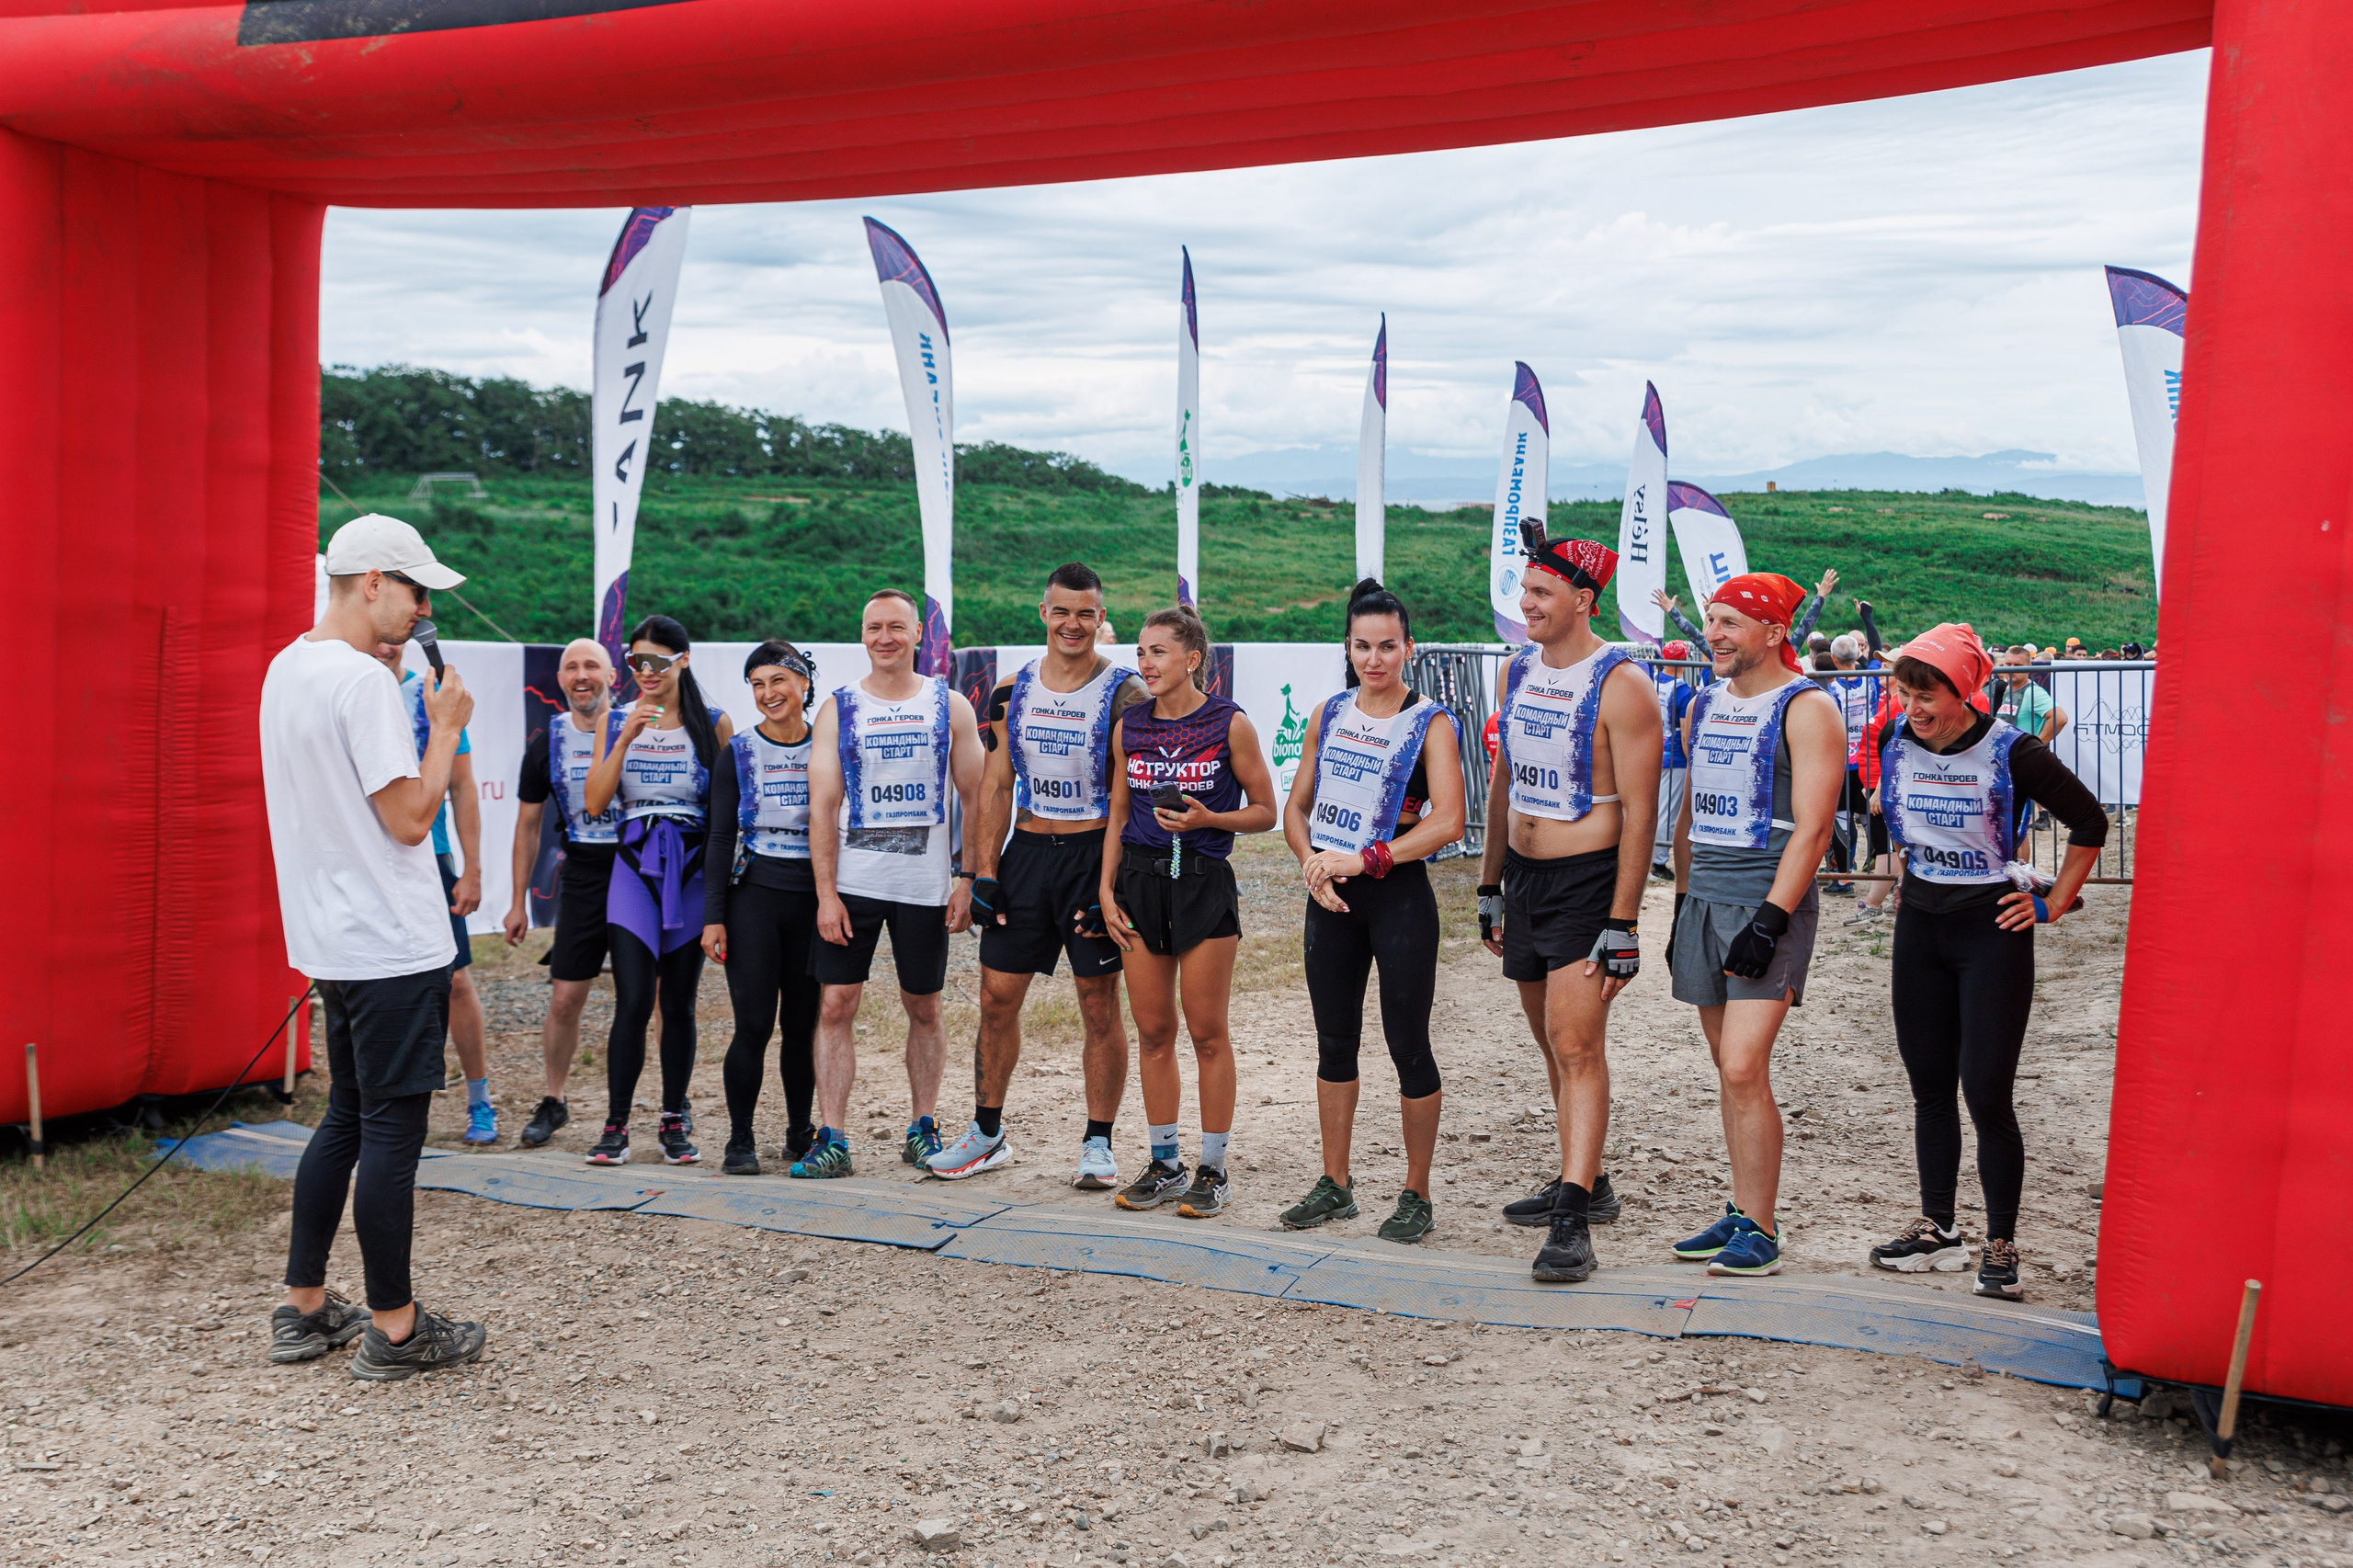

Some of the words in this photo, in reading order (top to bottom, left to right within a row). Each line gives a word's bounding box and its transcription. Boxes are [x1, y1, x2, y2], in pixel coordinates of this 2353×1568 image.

[612, 289, 654, 535] ANK
[1526, 684, 1544, 693] ГОНКА
[1546, 687, 1574, 699] ГЕРОЕВ
[1031, 707, 1055, 715] ГОНКА
[1057, 710, 1086, 718] ГЕРОЕВ
[1516, 706, 1569, 727] КОМАНДНЫЙ
[1027, 727, 1085, 744] КОМАНДНЫЙ
[1336, 728, 1359, 739] ГОНКА
[1360, 734, 1390, 746] ГЕРОЕВ
[1526, 722, 1551, 737] СТАРТ
[866, 733, 927, 747] КОМАНДНЫЙ
[1700, 735, 1751, 751] КОМАНДНЫЙ
[883, 747, 912, 758] СТАРТ
[1041, 742, 1067, 754] СТАРТ
[1324, 748, 1381, 772] КОМАНДНЫЙ
[1710, 751, 1733, 763] СТАРТ
[627, 761, 686, 772] КОМАНДНЫЙ
[1127, 758, 1221, 778] НСТРУКТОР
[1334, 763, 1361, 780] СТАРТ
[642, 772, 669, 781] СТАРТ
[1514, 762, 1559, 790] 04910
[1913, 772, 1943, 781] ГОНКА
[1944, 774, 1978, 782] ГЕРОЕВ
[764, 783, 807, 795] КОМАНДН
[871, 783, 926, 803] 04908
[1033, 778, 1082, 798] 04901
[781, 794, 807, 805] СТАРТ
[1521, 794, 1561, 809] ГАЗПРОМБАНК
[1695, 792, 1737, 817] 04903
[1908, 797, 1982, 813] КОМАНДНЫЙ
[886, 810, 927, 818] ГАЗПРОМБАНК
[1043, 805, 1085, 813] ГАЗПРОМБАНК
[1928, 812, 1961, 826] СТАРТ
[1698, 824, 1736, 835] ГАЗПРОМБАНК
[1924, 846, 1988, 869] 04905
[1937, 869, 1990, 877] ГАЗПРОМБАНК
